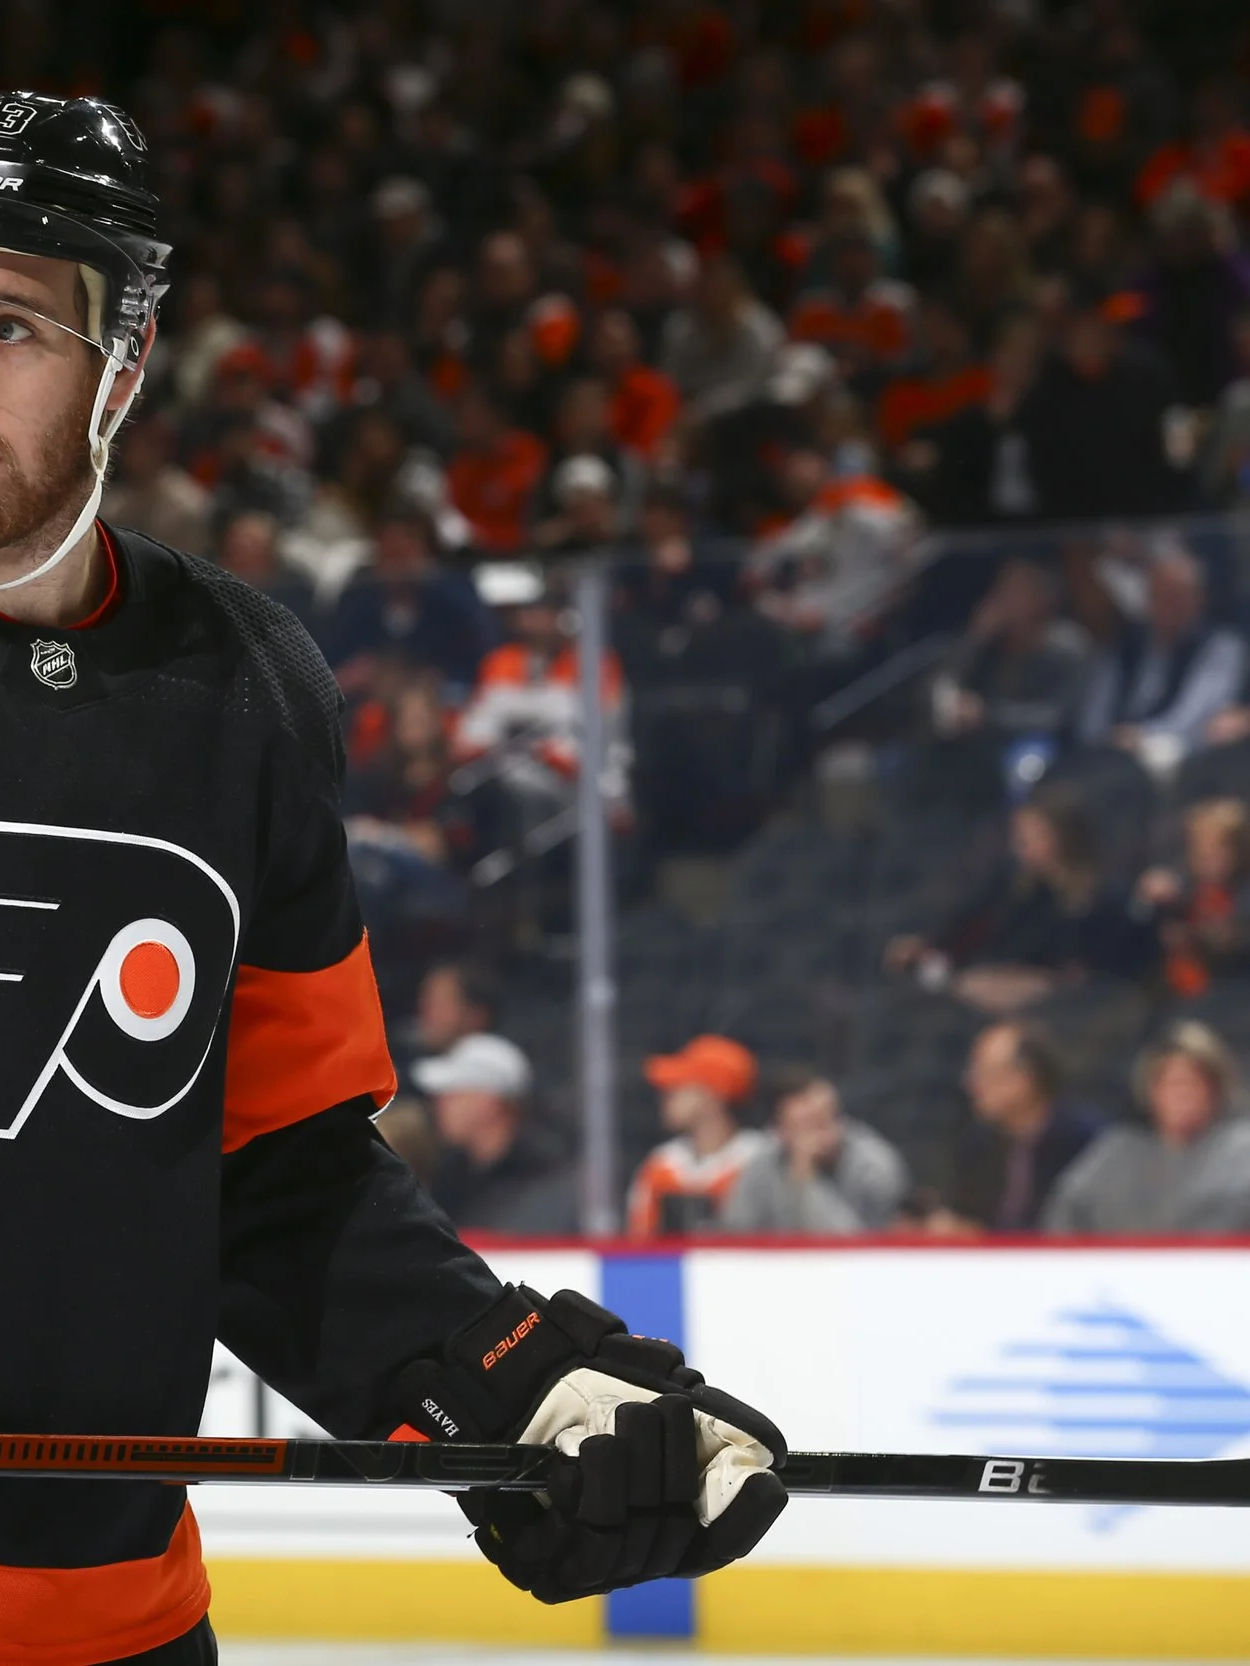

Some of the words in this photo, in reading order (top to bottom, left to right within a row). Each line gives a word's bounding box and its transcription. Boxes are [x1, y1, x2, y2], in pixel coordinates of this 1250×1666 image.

[42, 655, 68, 676] NHL
[482, 1311, 542, 1371] BAUER
[421, 1397, 460, 1438] HAYES
